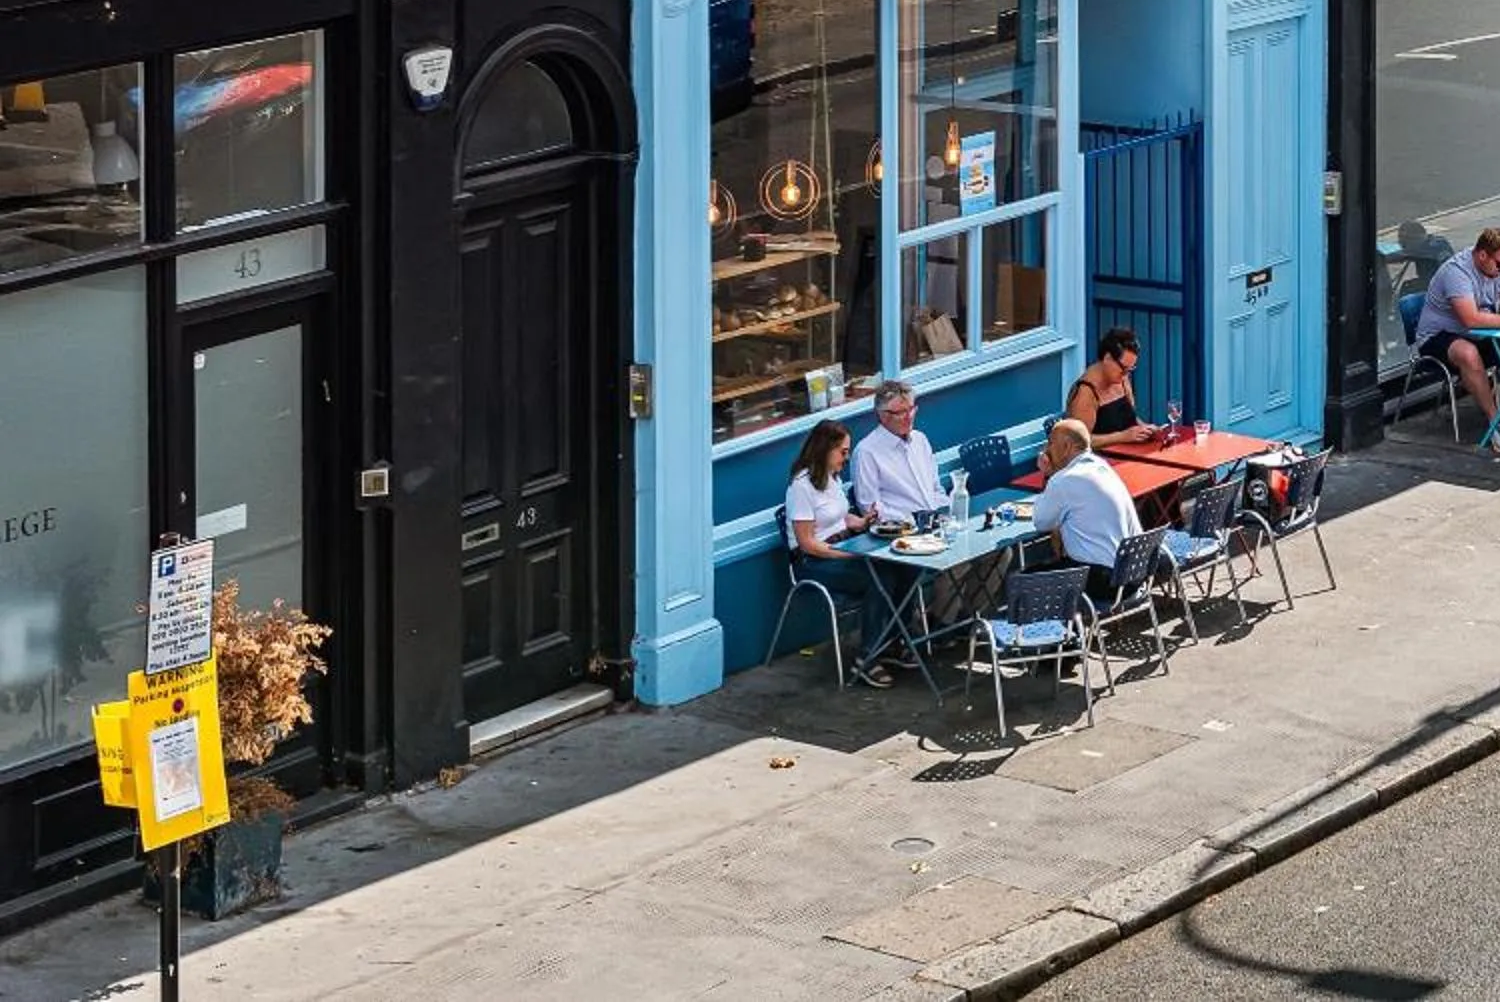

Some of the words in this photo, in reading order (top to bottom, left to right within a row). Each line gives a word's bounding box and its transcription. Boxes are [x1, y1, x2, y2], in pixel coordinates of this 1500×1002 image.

[234, 248, 261, 279] 43
[516, 507, 537, 528] 43
[146, 666, 205, 690] WARNING
